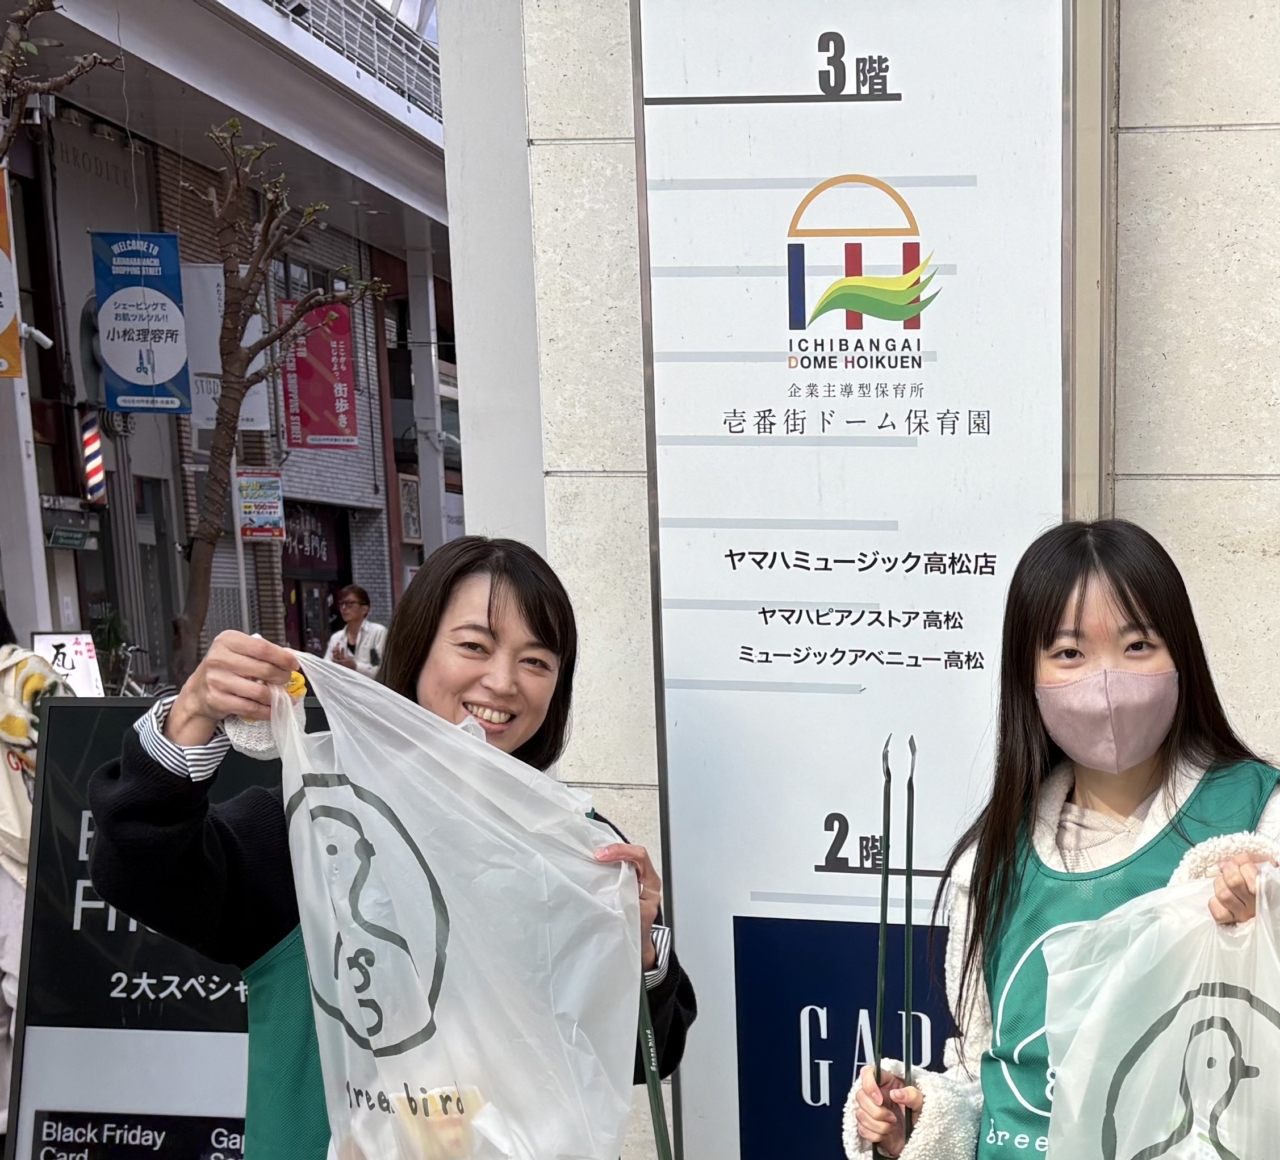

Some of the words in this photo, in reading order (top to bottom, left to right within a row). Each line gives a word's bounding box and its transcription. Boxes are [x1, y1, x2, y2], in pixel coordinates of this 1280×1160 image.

[817, 31, 889, 96] 3階
[111, 239, 149, 255] WELCOME
[148, 242, 160, 256] TO
[141, 267, 161, 275] STREET
[113, 301, 167, 311] シェービングで
[106, 327, 179, 343] 小松理容所
[789, 338, 921, 352] ICHIBANGAI
[339, 341, 347, 372] ここから
[788, 356, 838, 369] DOME
[844, 356, 923, 369] HOIKUEN
[287, 373, 299, 414] SHOPPING
[787, 382, 925, 399] 企業主導型保育所
[290, 415, 302, 444] STREET
[722, 408, 991, 436] 壱番街ドーム保育園
[724, 549, 997, 576] ヤマハミュージック高松店
[758, 606, 964, 630] ヤマハピアノストア高松
[738, 645, 985, 671] ミュージックアベニュー高松
[800, 1005, 932, 1107] GAP
[42, 1120, 99, 1143] Black
[102, 1123, 166, 1150] Friday
